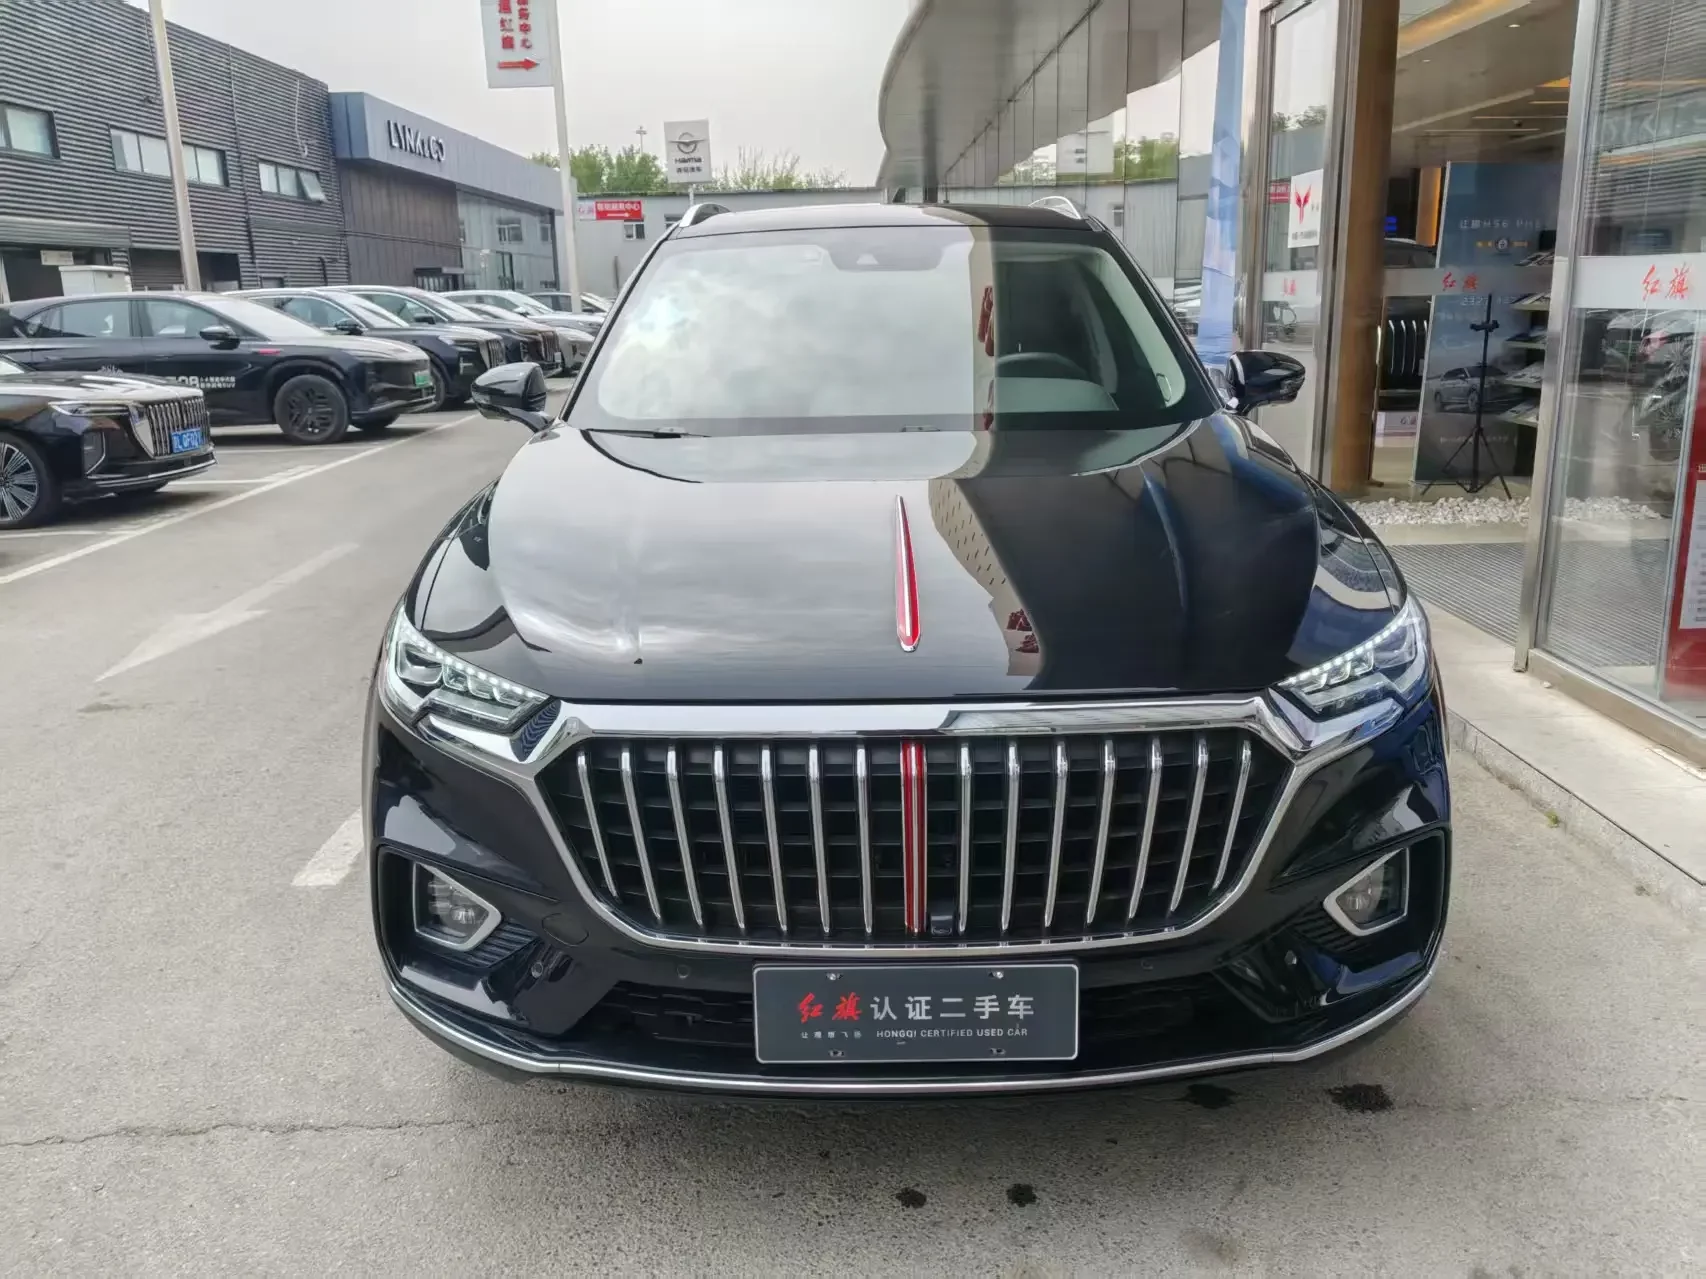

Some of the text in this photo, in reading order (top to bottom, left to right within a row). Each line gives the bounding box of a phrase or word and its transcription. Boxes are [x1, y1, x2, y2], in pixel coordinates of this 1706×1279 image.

[1641, 262, 1690, 301] 红旗
[876, 1028, 1028, 1038] HONGQI CERTIFIED USED CAR
